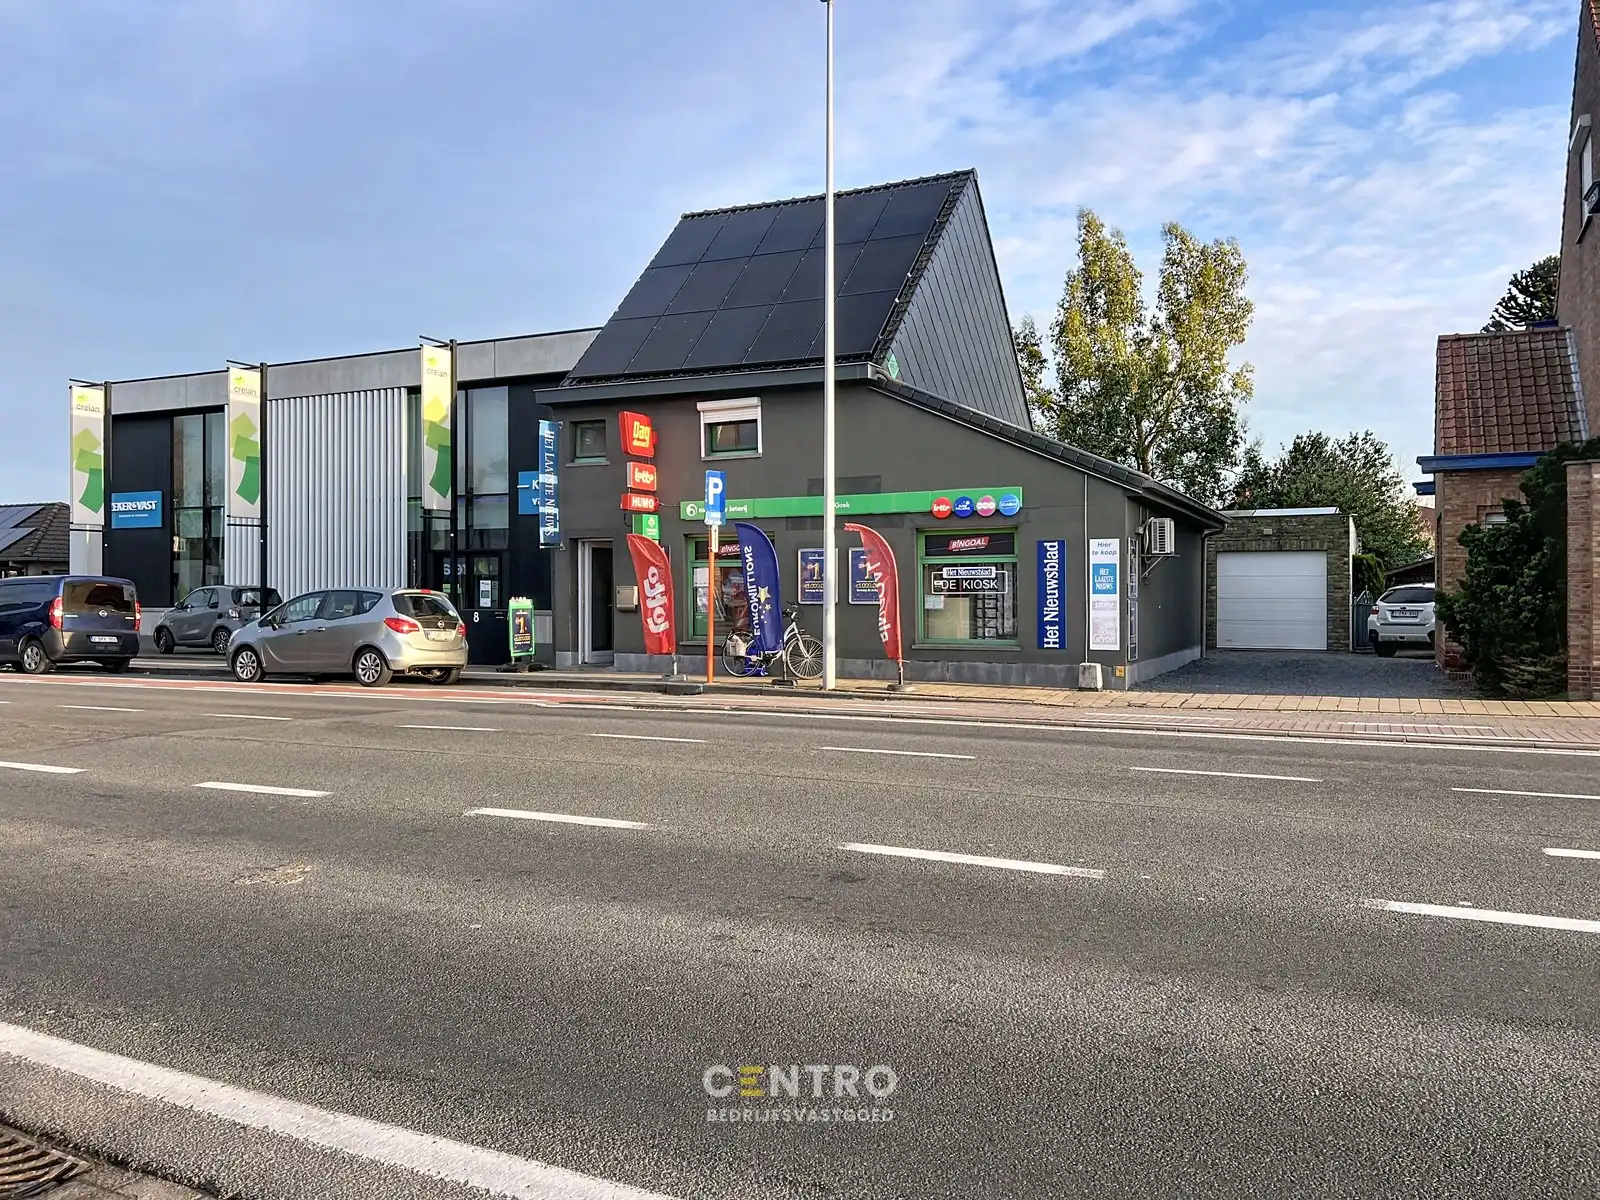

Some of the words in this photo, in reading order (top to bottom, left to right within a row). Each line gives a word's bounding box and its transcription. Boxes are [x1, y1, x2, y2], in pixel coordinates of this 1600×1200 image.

[233, 385, 257, 396] crelan
[76, 403, 101, 413] crelan
[544, 430, 555, 448] HET
[708, 476, 723, 505] P
[632, 496, 654, 509] HUMO
[729, 505, 748, 513] loterij
[1100, 549, 1117, 557] koop
[947, 568, 957, 576] Het
[958, 567, 991, 576] Nieuwsblad
[941, 580, 957, 590] DE
[962, 579, 999, 590] KIOSK
[1043, 541, 1059, 622] Nieuwsblad
[473, 611, 480, 623] 8
[1043, 624, 1060, 649] Het
